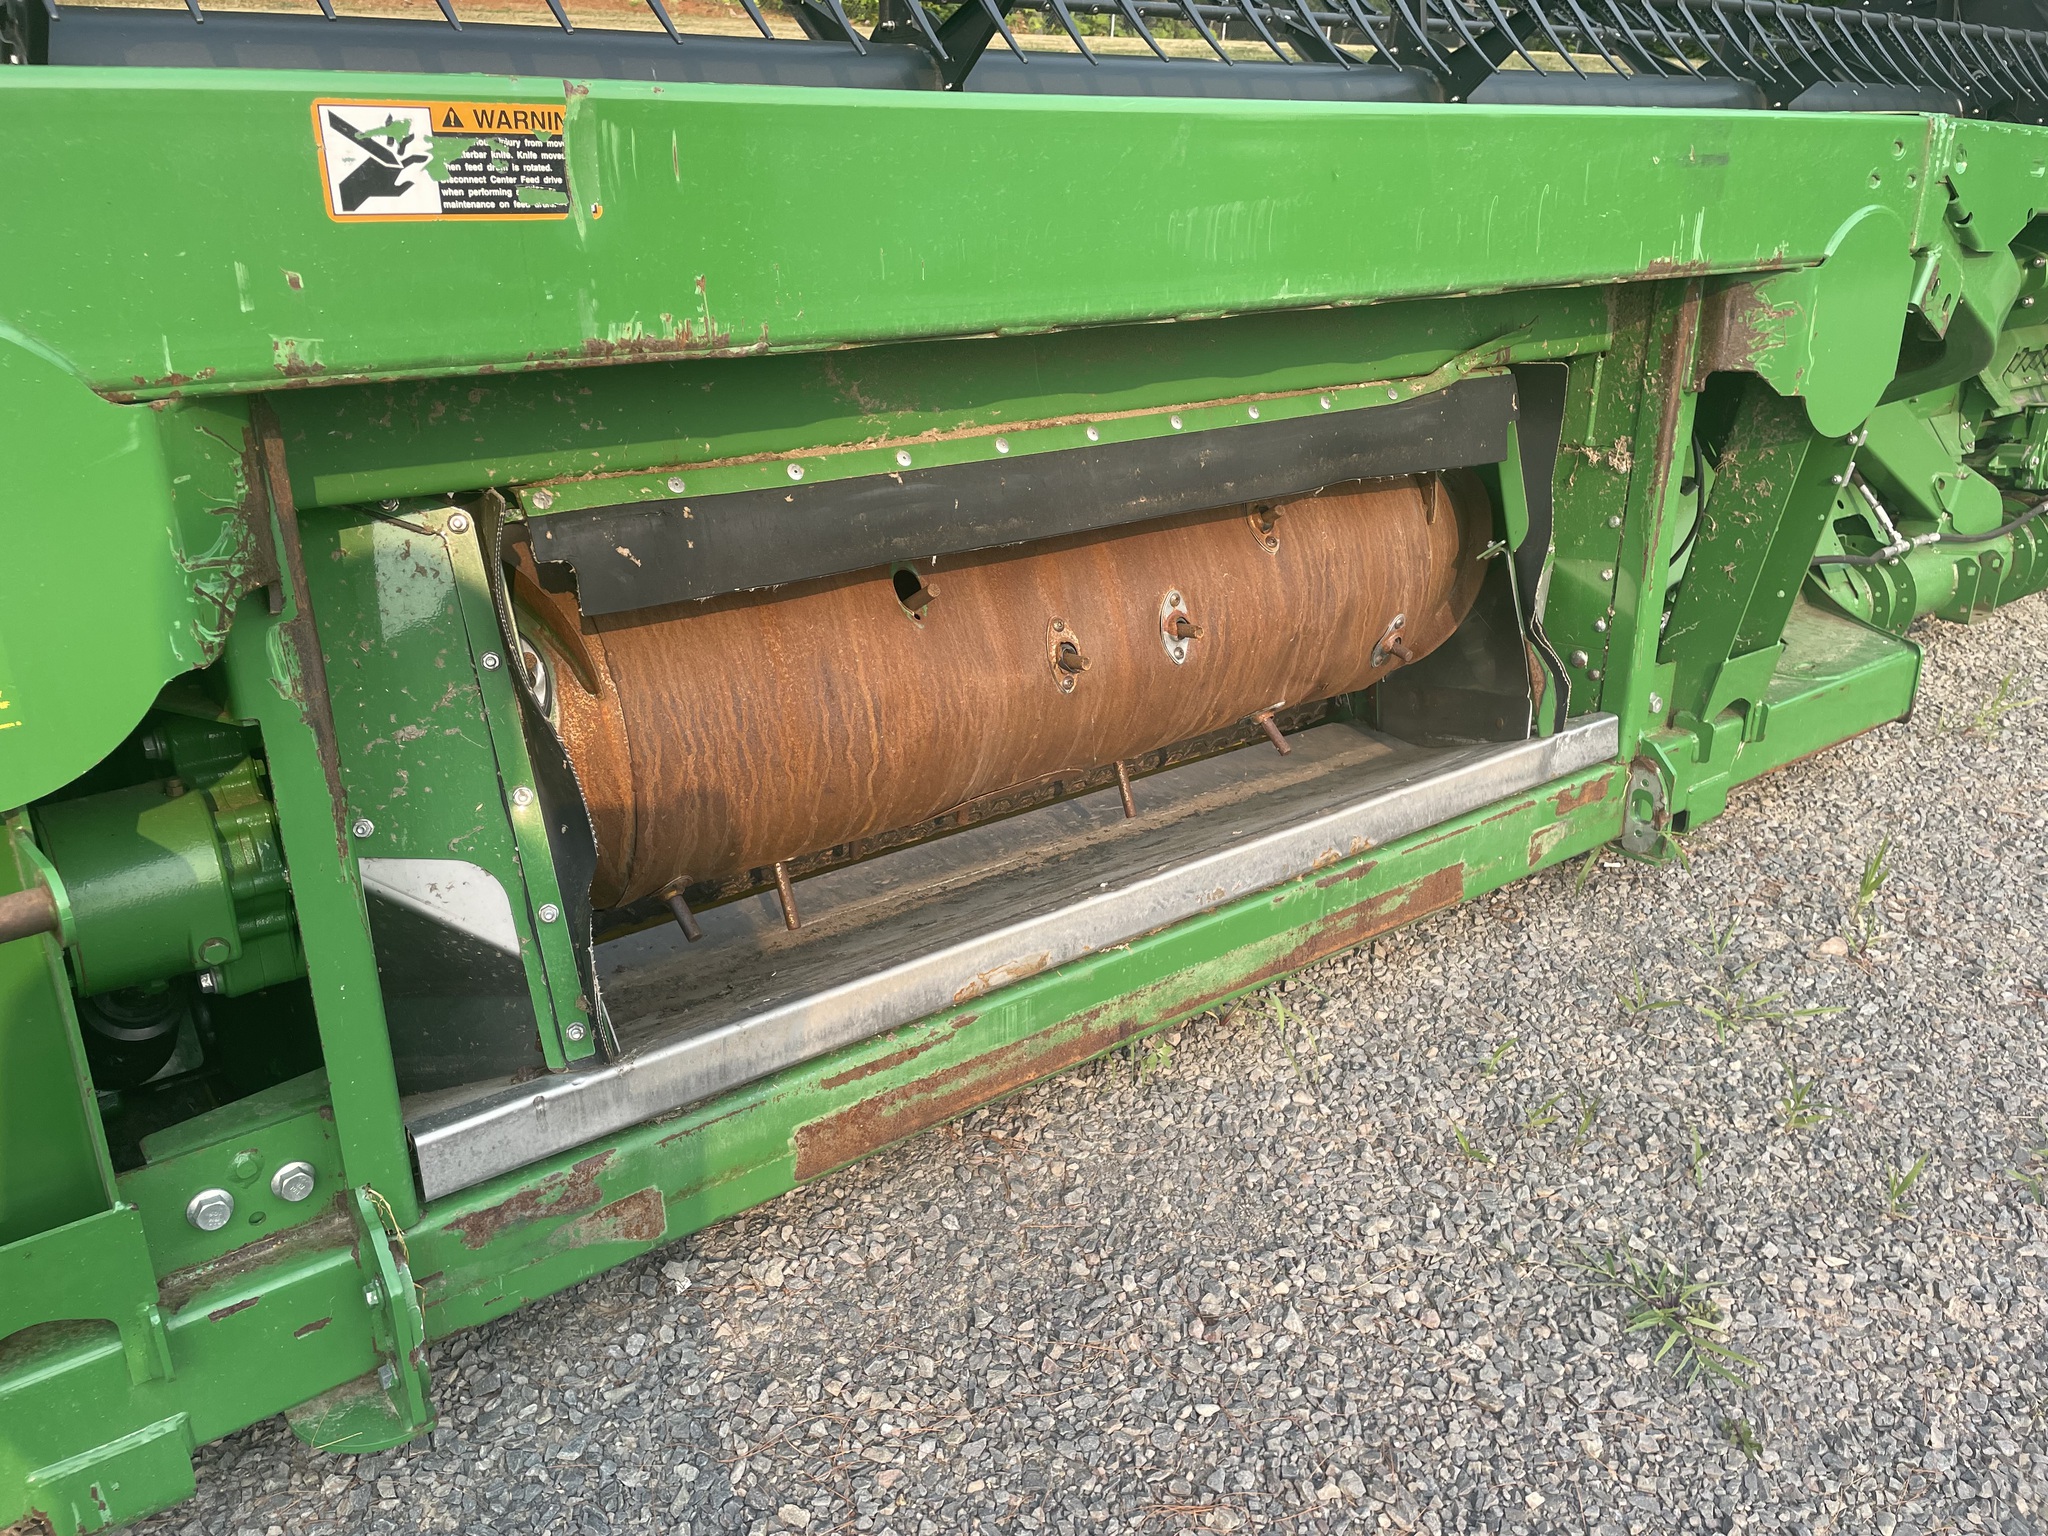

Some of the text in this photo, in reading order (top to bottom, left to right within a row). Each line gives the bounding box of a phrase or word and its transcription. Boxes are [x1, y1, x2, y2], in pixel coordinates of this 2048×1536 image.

[524, 138, 543, 148] from
[546, 140, 564, 148] mov
[460, 150, 487, 159] terbar
[516, 150, 538, 159] Knife
[443, 161, 462, 171] hen
[464, 162, 484, 172] feed
[511, 162, 520, 172] is
[522, 163, 553, 172] rotated.
[489, 174, 518, 184] Center
[520, 174, 540, 184] Feed
[543, 175, 563, 184] drive
[441, 187, 465, 196] when
[467, 187, 513, 198] performing
[442, 199, 497, 209] maintenance
[498, 200, 511, 209] on
